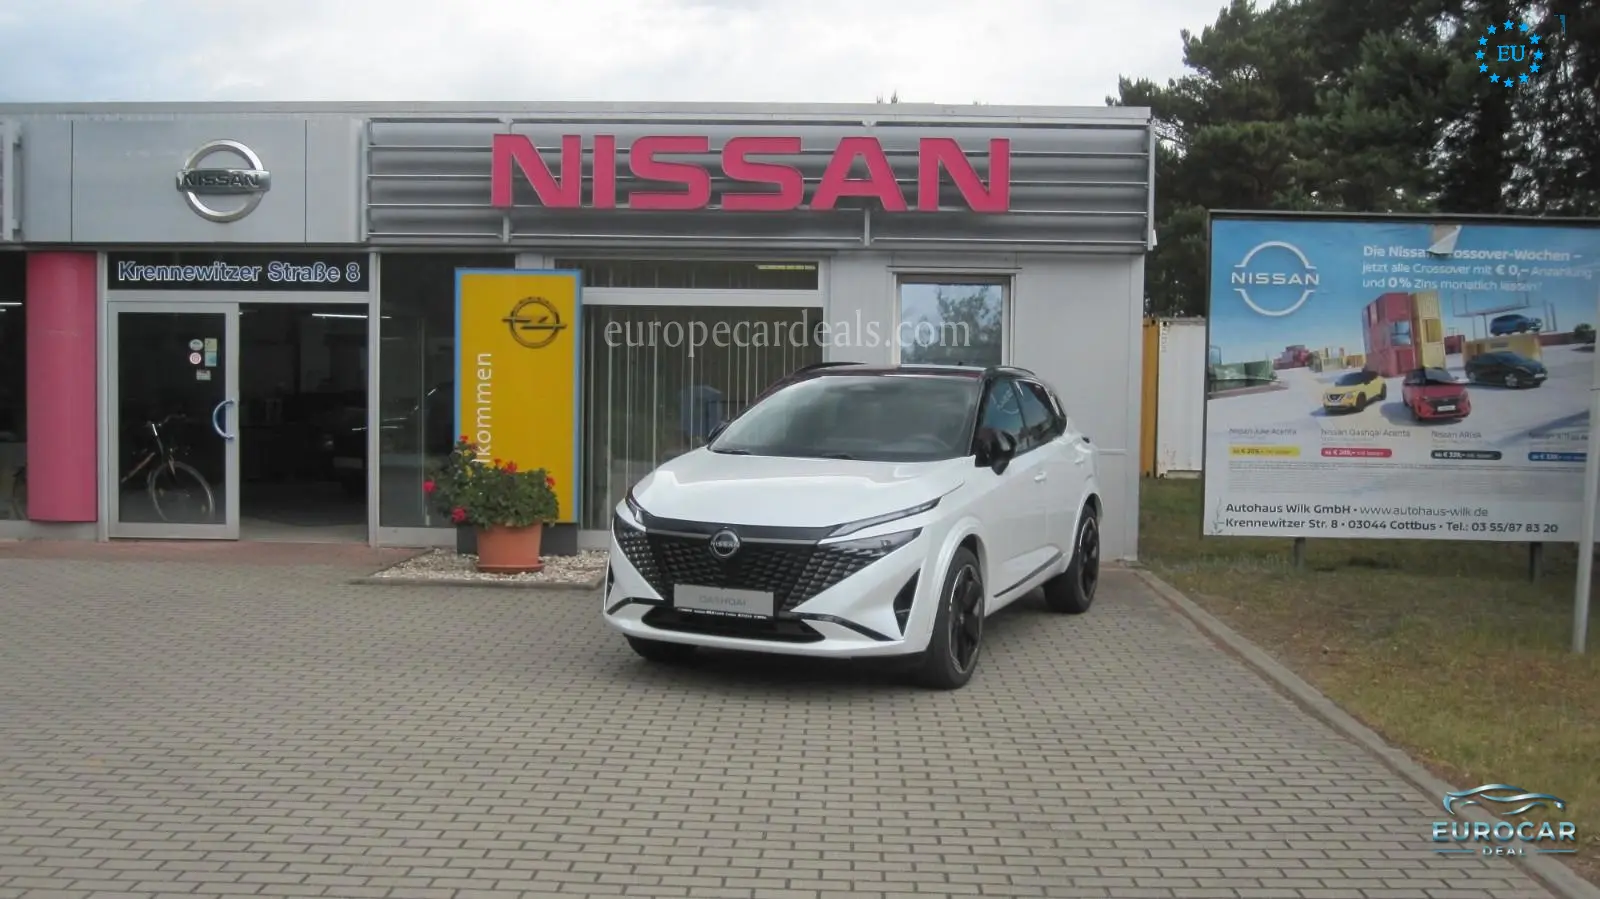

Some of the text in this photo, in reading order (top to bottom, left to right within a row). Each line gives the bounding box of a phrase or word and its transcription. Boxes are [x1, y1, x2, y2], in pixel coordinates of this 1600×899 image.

[181, 171, 259, 188] NISSAN
[491, 133, 1011, 213] NISSAN
[1363, 245, 1385, 257] Die
[118, 261, 361, 283] Krennewitzer Straße 8
[1362, 262, 1388, 275] jetzt
[1391, 263, 1410, 273] alle
[1413, 263, 1469, 274] Crossover
[1473, 264, 1492, 275] mit
[1495, 264, 1505, 275] €
[1231, 271, 1320, 286] NISSAN
[1363, 278, 1385, 288] und
[1414, 279, 1438, 289] Zins
[1440, 279, 1497, 291] monatlich
[472, 352, 492, 462] lkommen
[1226, 503, 1488, 517] Autohaus Wilk GmbH www.autohaus-wilk.de
[1226, 518, 1559, 533] Krennewitzer Str. 8 03044 Cottbus Tel.: 03 55/87 83 20
